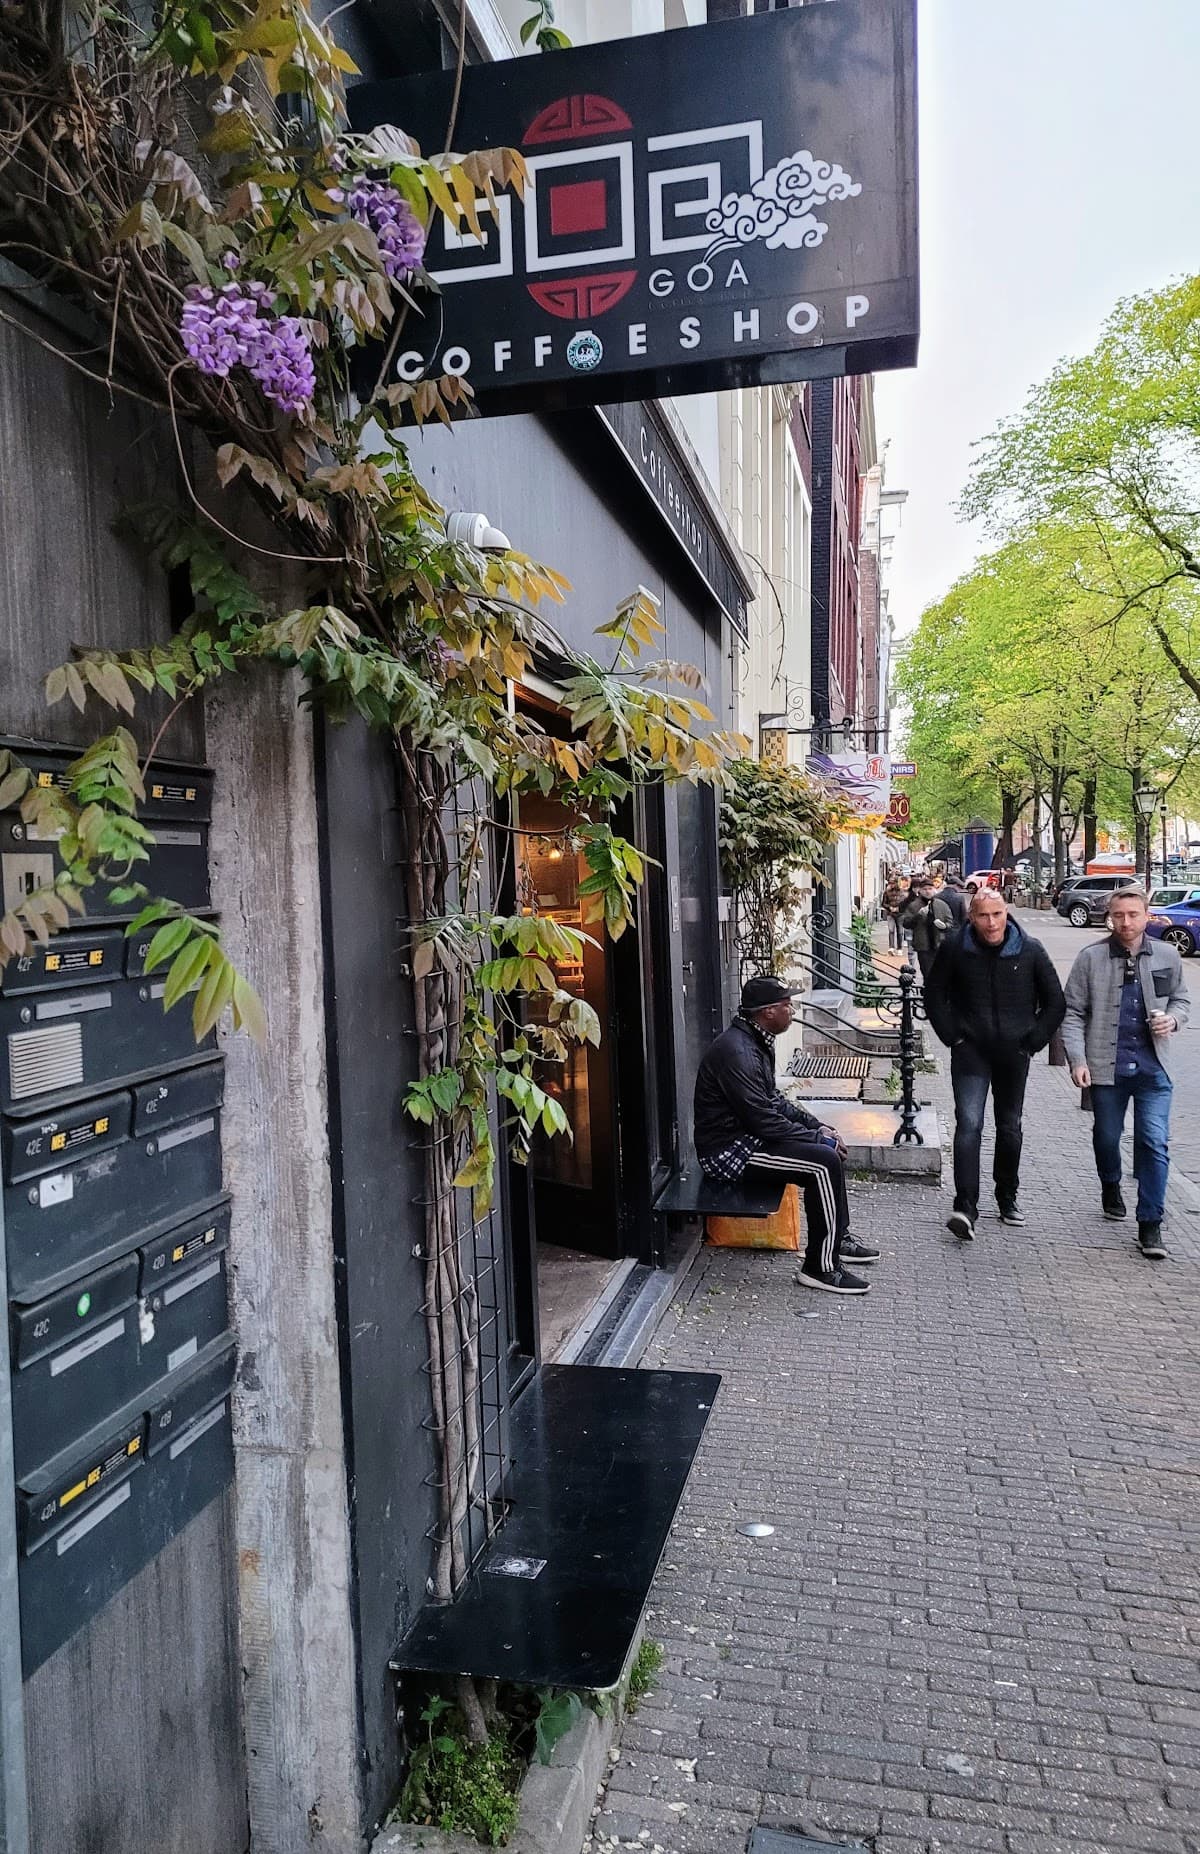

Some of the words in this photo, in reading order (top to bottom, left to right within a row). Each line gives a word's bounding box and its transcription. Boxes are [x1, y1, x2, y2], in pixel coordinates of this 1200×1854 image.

[649, 259, 749, 297] GOA
[397, 295, 869, 382] COFFESHOP
[640, 426, 702, 557] Coffeeshop
[26, 1138, 43, 1156] 42E
[34, 1318, 50, 1337] 42C
